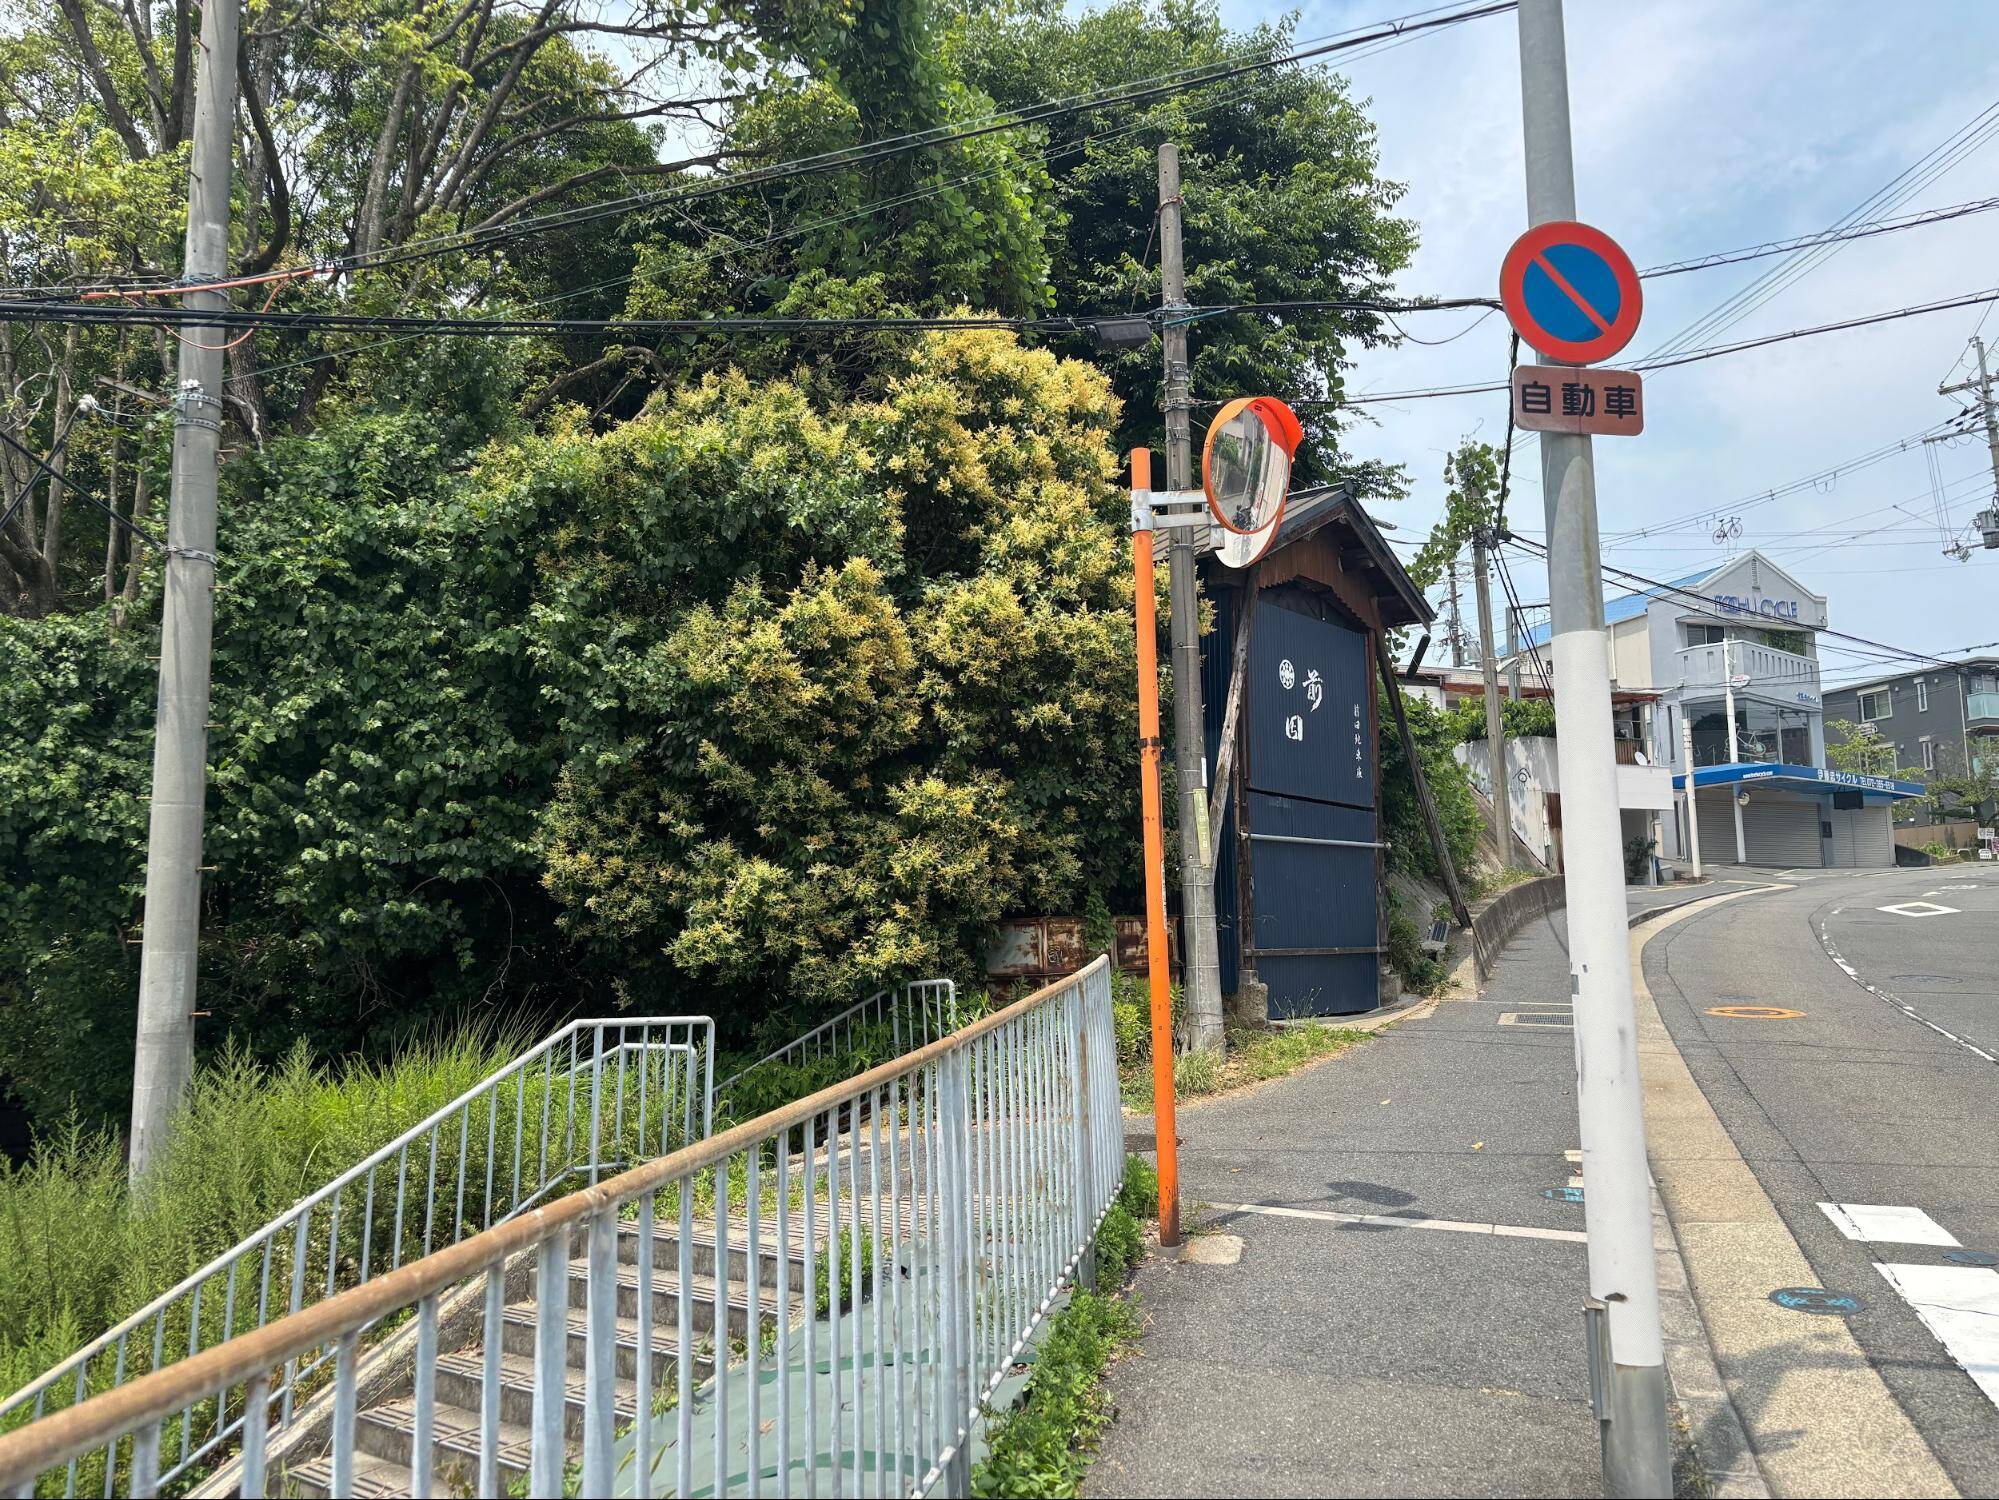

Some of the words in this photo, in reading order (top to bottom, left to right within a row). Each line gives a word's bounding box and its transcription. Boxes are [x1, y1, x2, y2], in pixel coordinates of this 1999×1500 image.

[1521, 380, 1638, 420] 自動車
[1760, 598, 1798, 619] CYCLE
